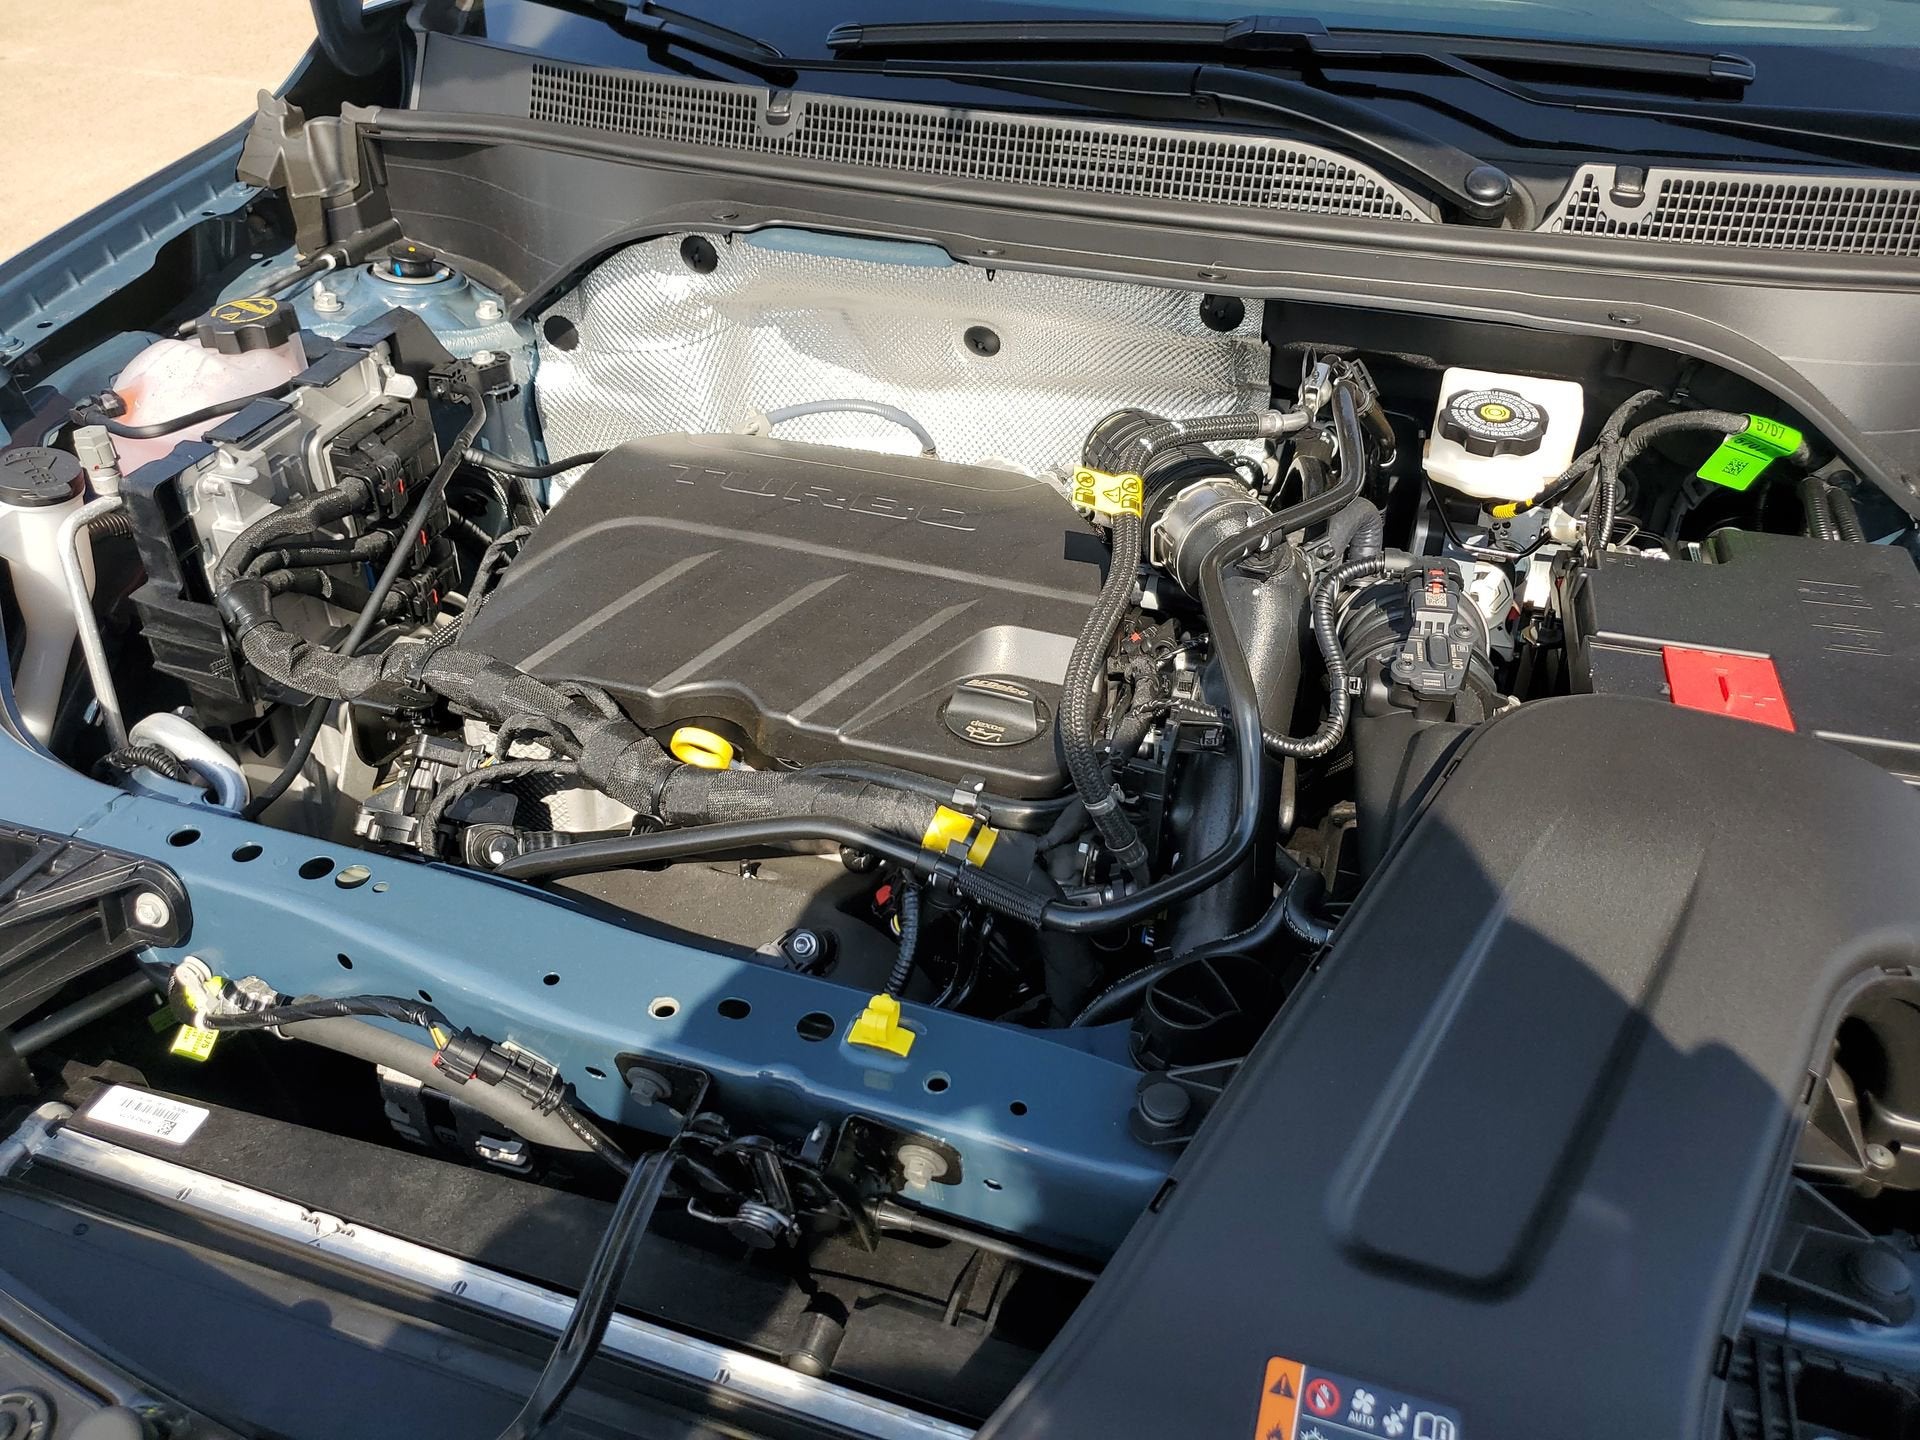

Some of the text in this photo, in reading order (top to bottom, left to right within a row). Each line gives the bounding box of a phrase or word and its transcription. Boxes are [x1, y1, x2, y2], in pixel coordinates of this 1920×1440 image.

[1756, 418, 1786, 440] 5707
[668, 463, 977, 532] TURBO
[963, 679, 1029, 697] ACDelco
[970, 720, 1007, 733] dexos
[1348, 1410, 1375, 1427] AUTO
